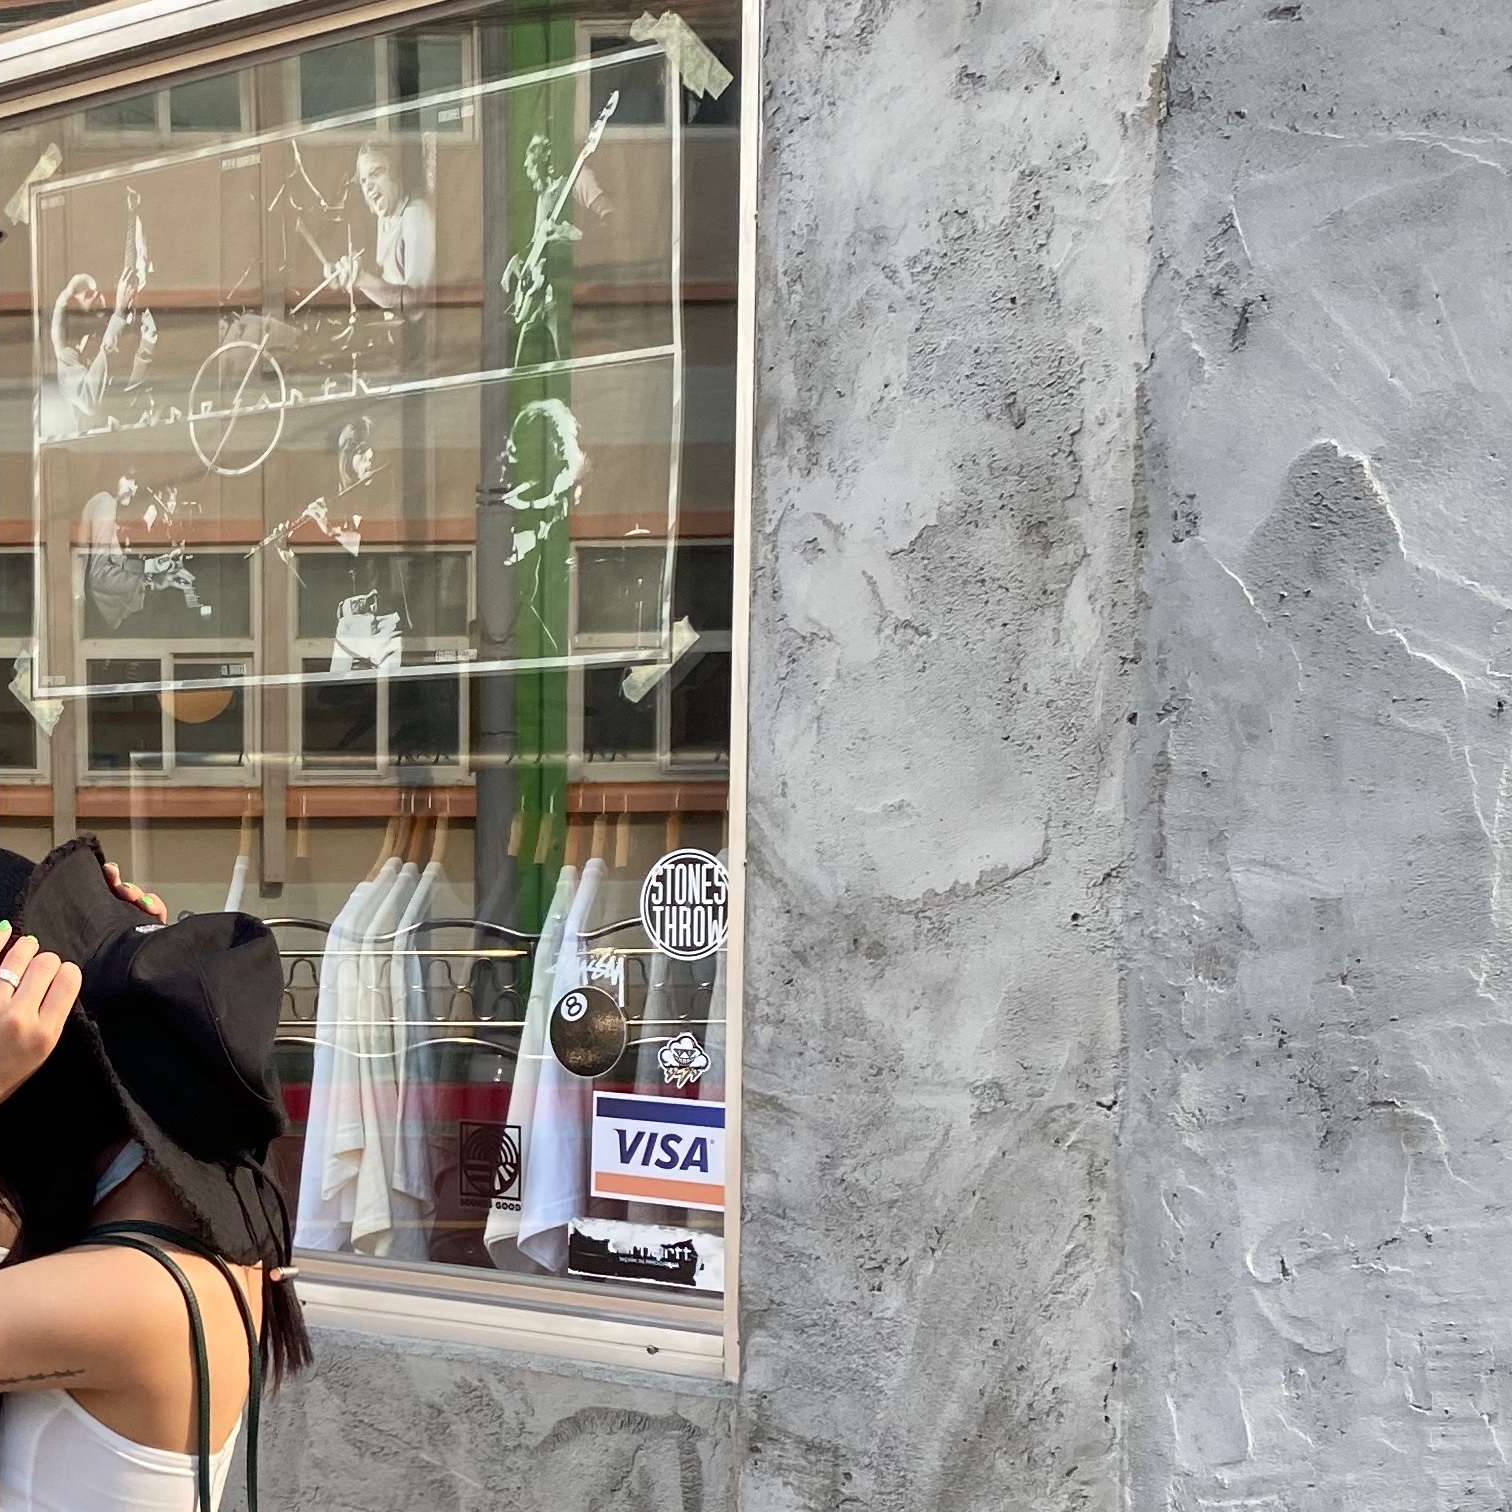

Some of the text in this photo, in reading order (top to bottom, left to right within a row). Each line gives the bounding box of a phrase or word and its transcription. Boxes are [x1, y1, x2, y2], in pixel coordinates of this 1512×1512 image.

[651, 863, 727, 948] STONES THROW
[613, 1128, 709, 1173] VISA
